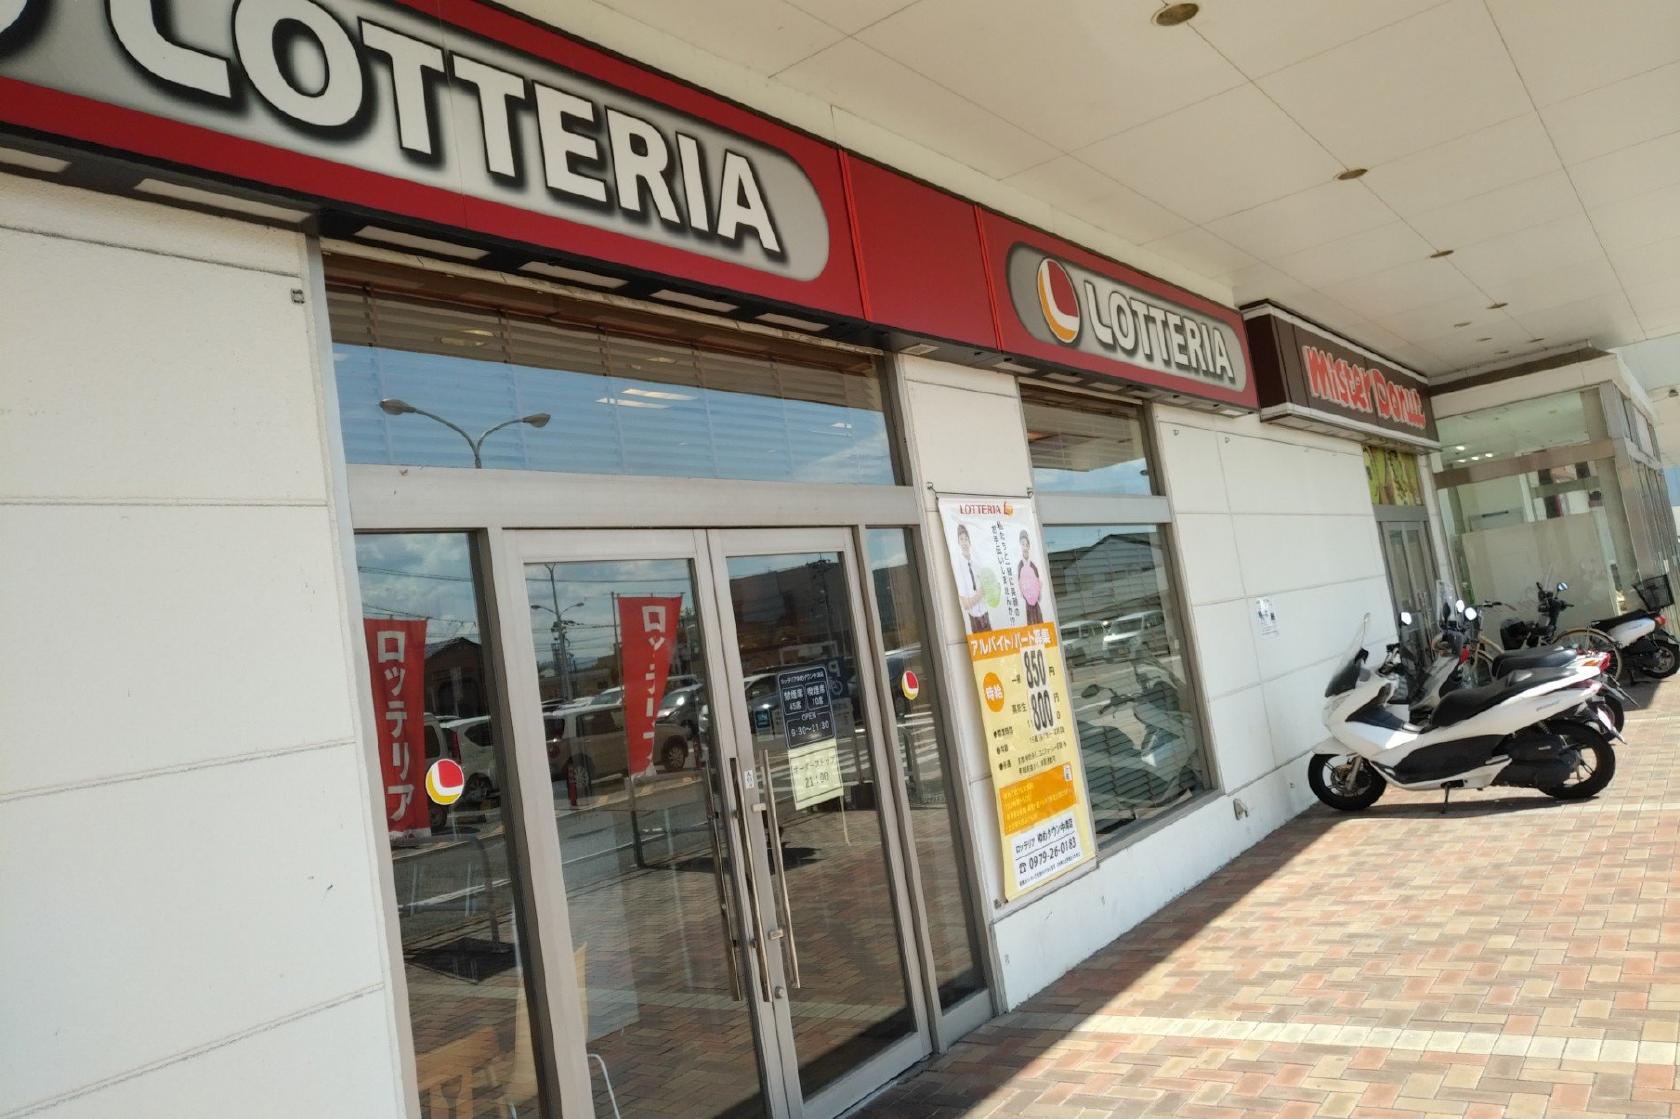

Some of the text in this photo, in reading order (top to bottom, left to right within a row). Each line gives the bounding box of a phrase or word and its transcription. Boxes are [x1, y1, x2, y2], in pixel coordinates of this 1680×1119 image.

[107, 0, 780, 253] LOTTERIA
[1084, 280, 1235, 379] LOTTERIA
[959, 504, 1001, 515] LOTTERIA
[1024, 649, 1046, 689] 850
[377, 629, 415, 822] ロッテリア
[801, 711, 817, 721] OPEN
[1031, 689, 1054, 731] 800
[1028, 836, 1077, 870] 0979-26-0183
